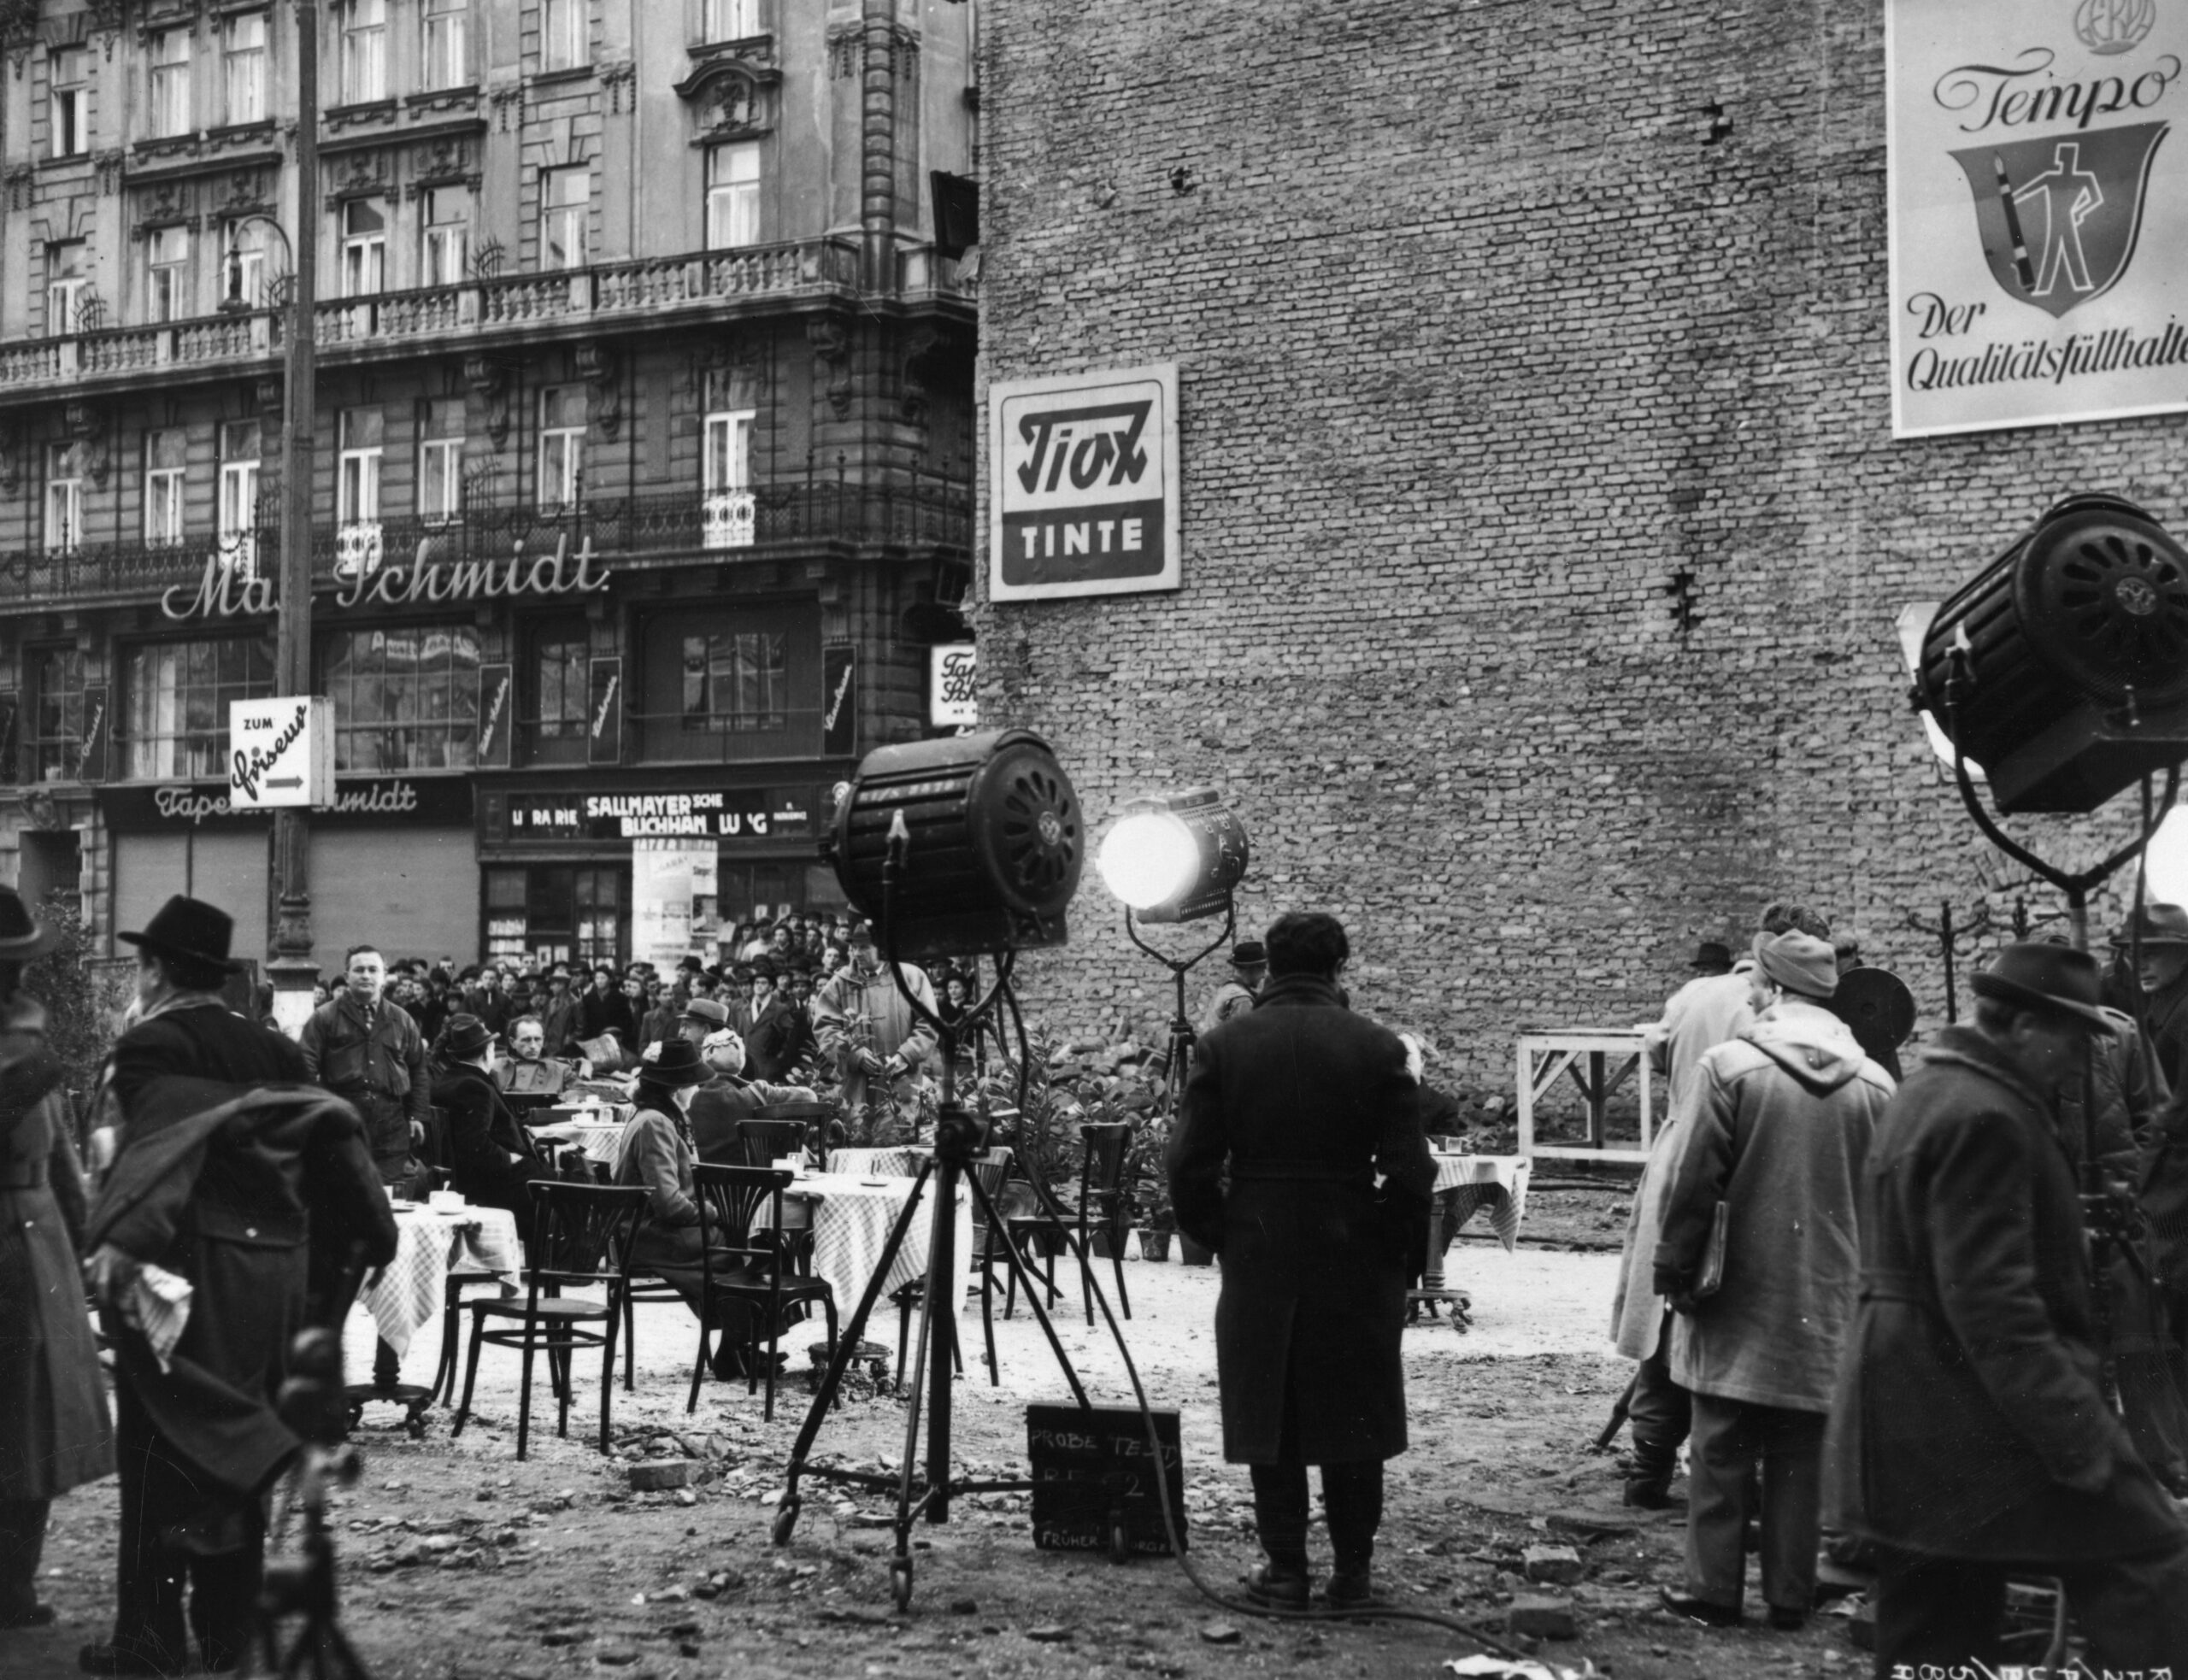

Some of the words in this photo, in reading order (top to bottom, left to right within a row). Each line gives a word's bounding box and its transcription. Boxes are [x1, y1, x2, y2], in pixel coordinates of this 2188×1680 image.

[1933, 47, 2181, 132] Tempo
[1907, 291, 1986, 338] Der
[1017, 400, 1153, 494] Tiox
[1021, 518, 1142, 559] TINTE
[162, 555, 315, 620] Ma
[244, 718, 273, 730] ZUM
[1031, 1430, 1097, 1449] PROBE
